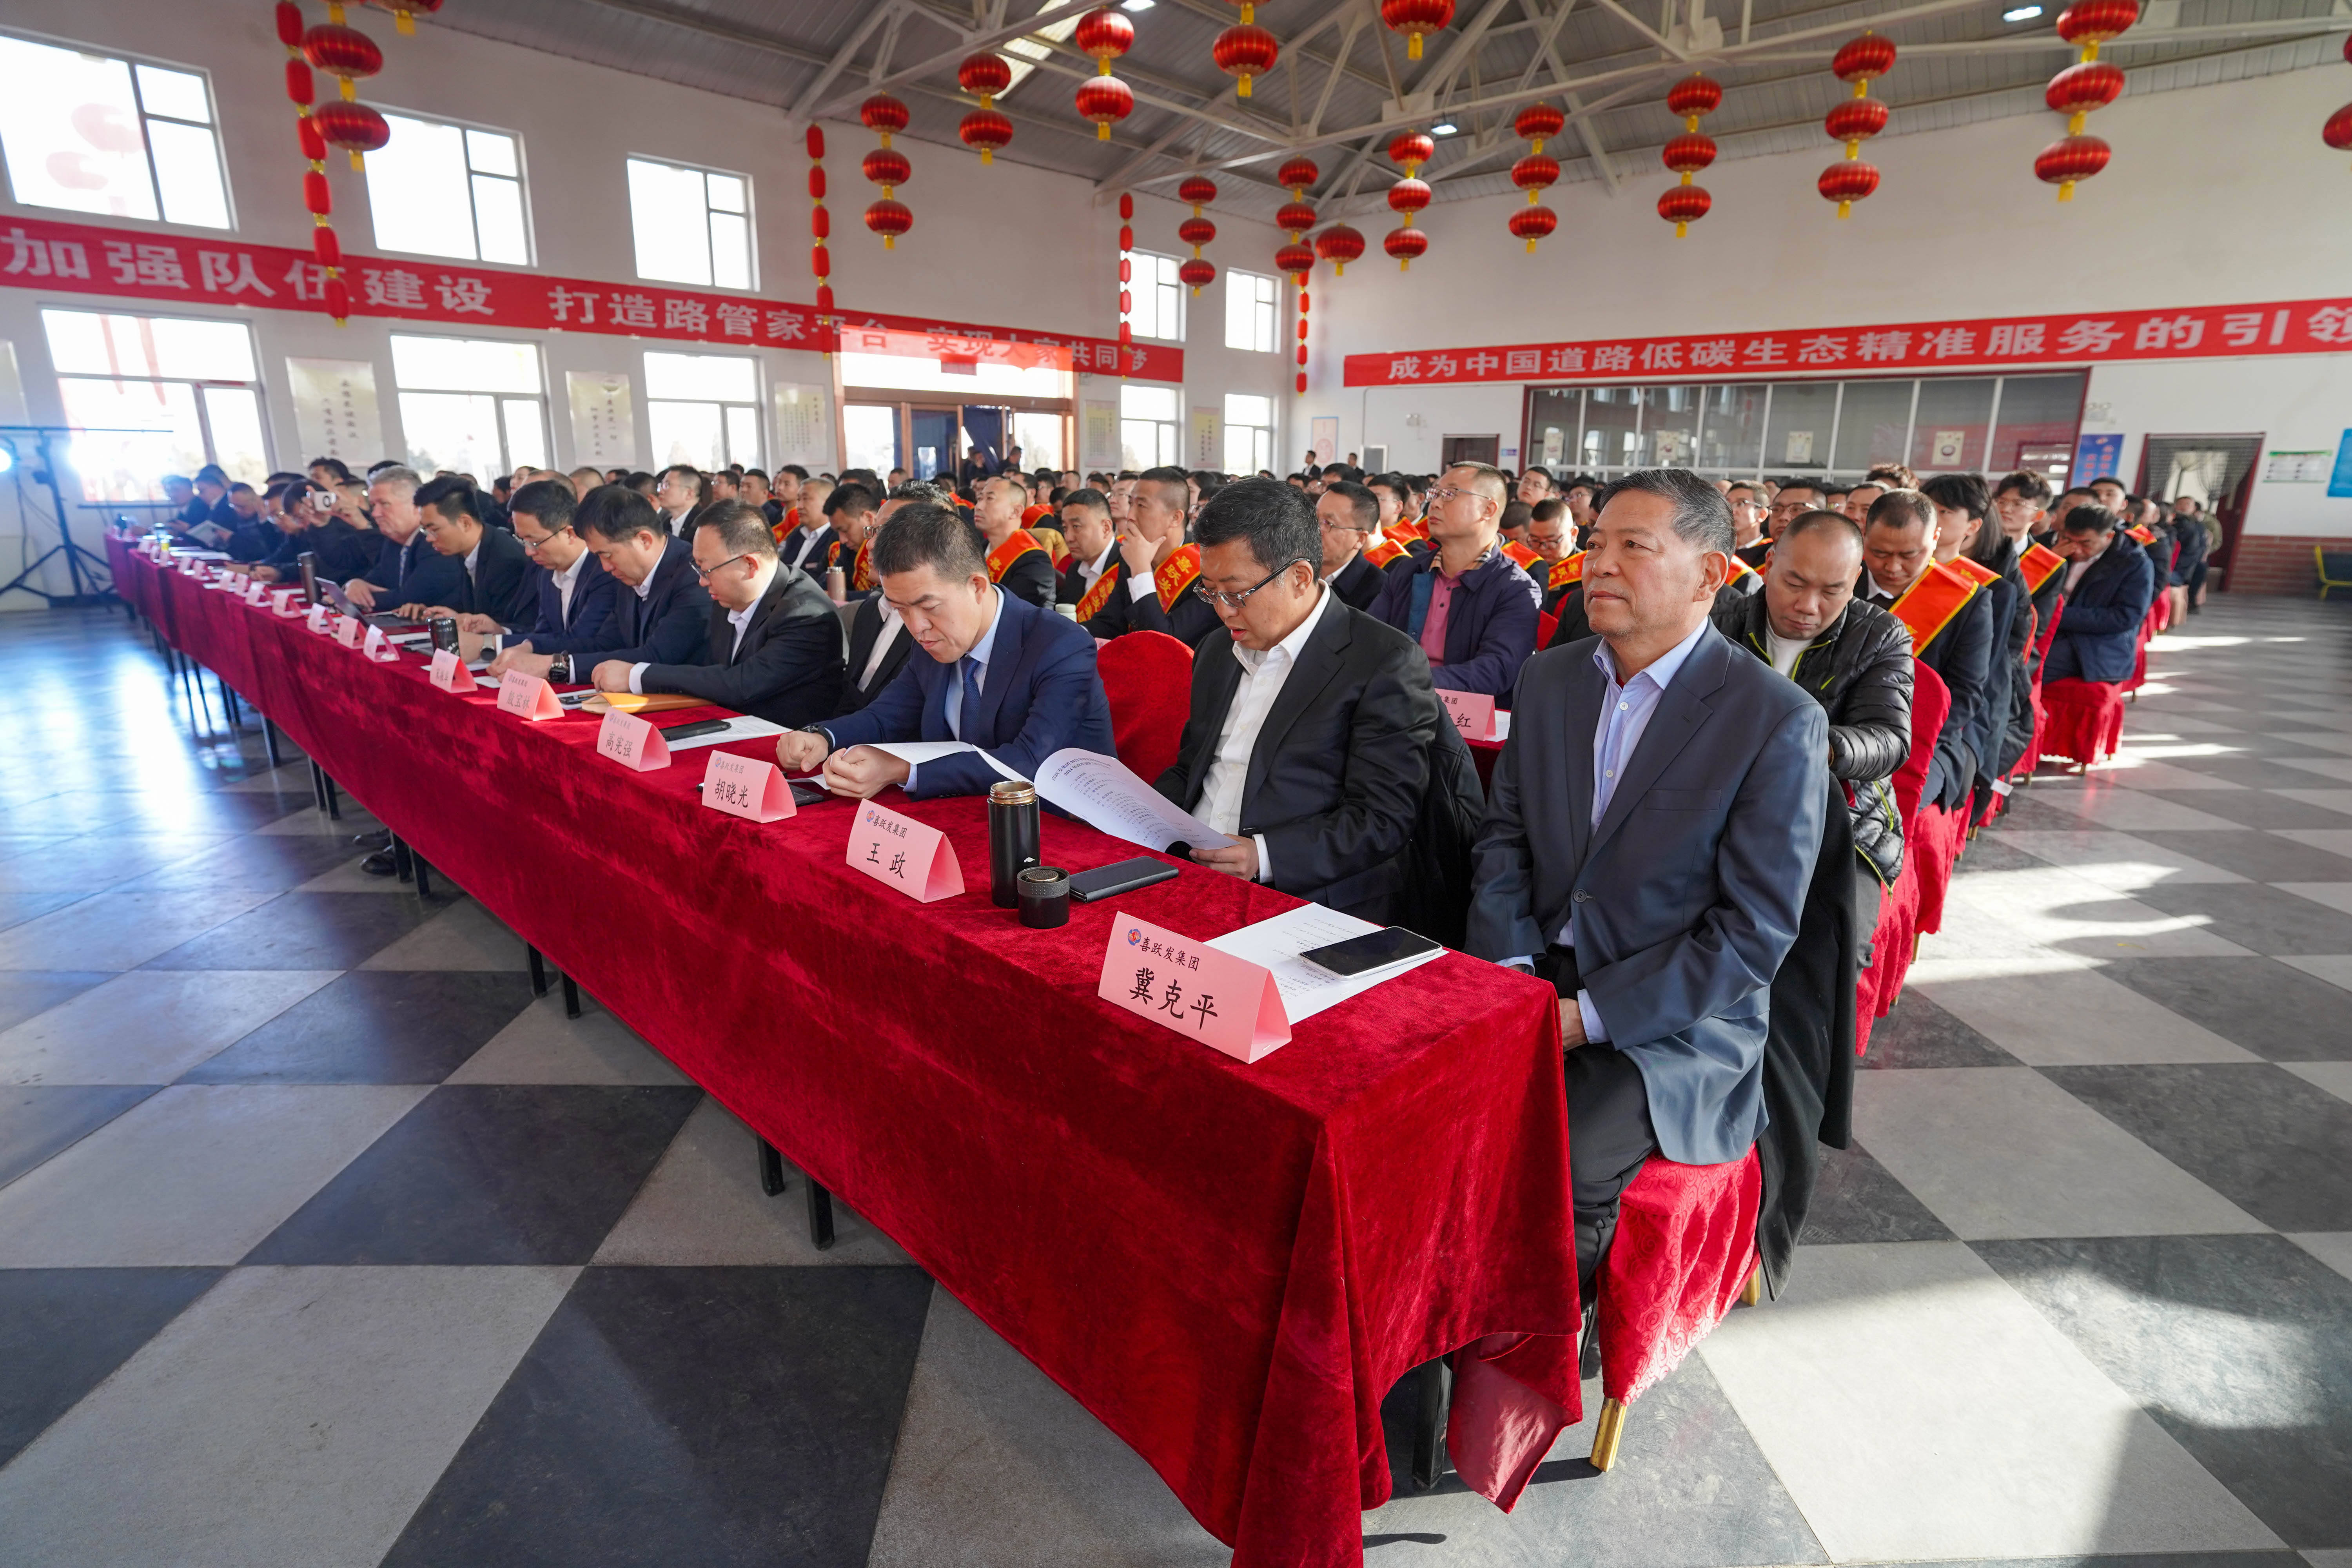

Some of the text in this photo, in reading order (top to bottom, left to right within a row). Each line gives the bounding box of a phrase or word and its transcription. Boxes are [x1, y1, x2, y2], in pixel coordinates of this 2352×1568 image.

[4, 228, 1148, 371] 加强队伍建设 打造路管家平台 实现大家共同梦
[1388, 306, 2352, 379] 成为中国道路低碳生态精准服务的引领
[606, 731, 633, 758] 高宪强
[720, 760, 744, 774] 喜跃发集团
[715, 778, 748, 808] 胡晓光
[873, 815, 907, 839] 喜跃发集团
[866, 843, 906, 878] 王政
[1140, 937, 1200, 971] 喜跃发集团
[1129, 967, 1218, 1030] 冀克平
